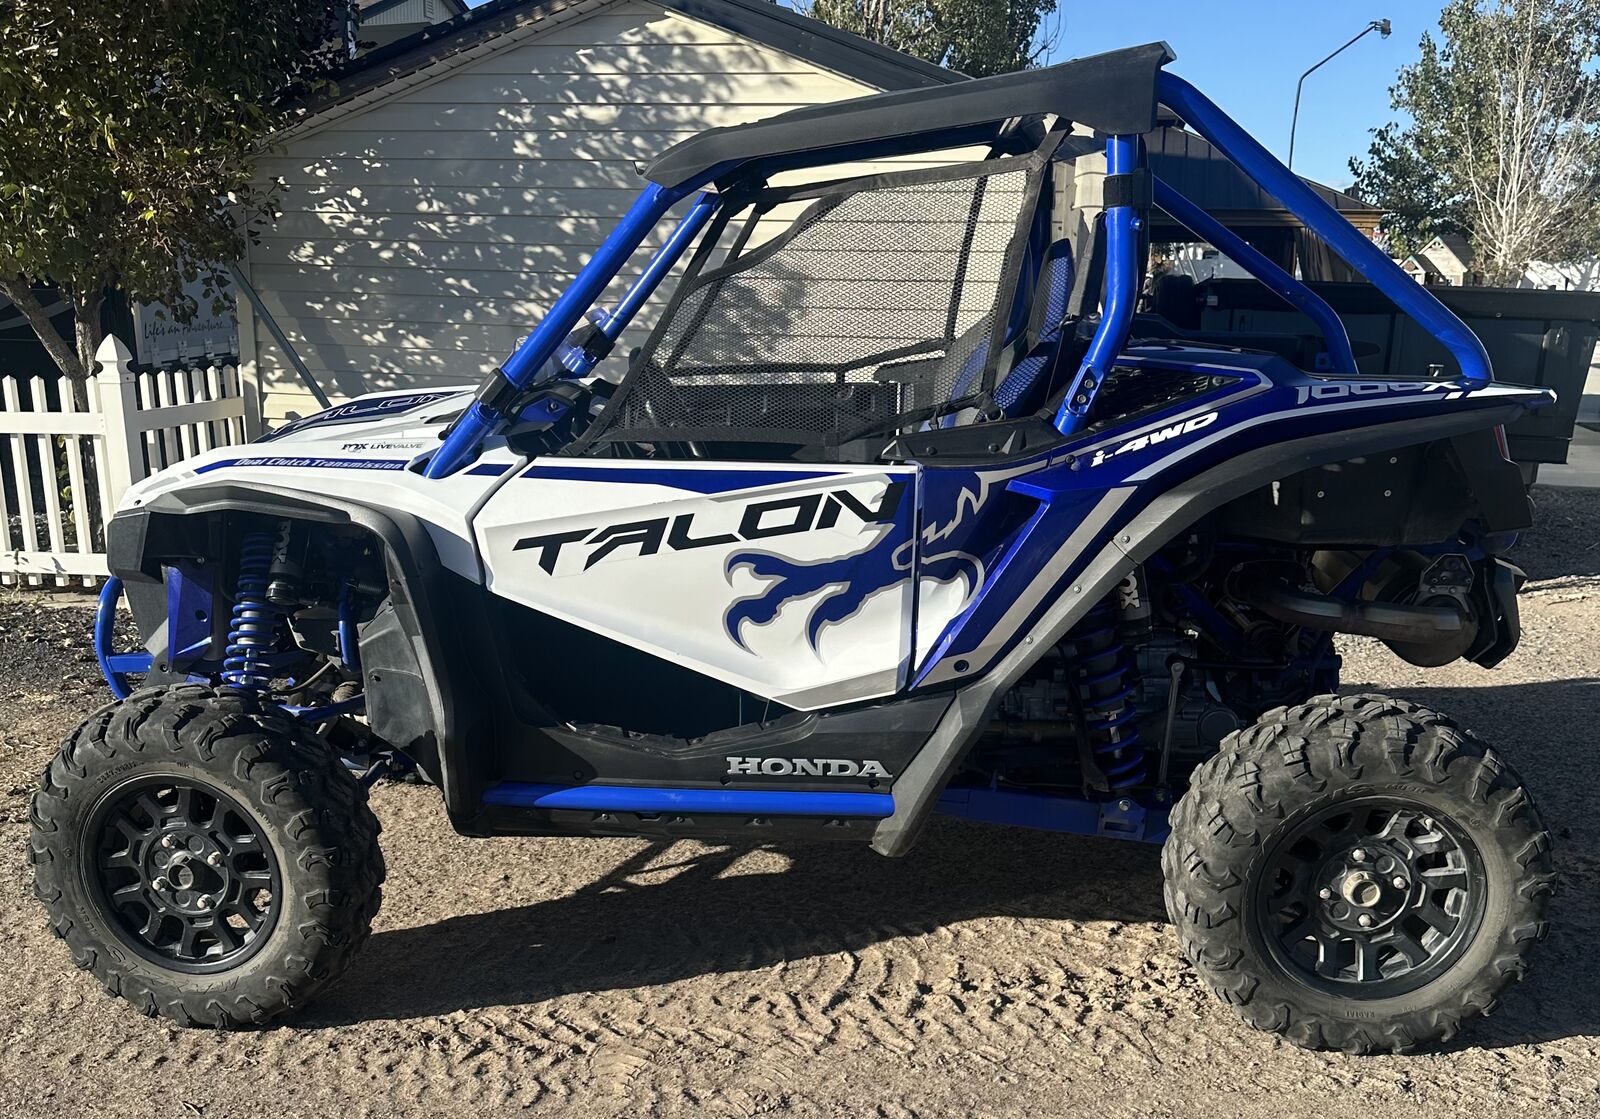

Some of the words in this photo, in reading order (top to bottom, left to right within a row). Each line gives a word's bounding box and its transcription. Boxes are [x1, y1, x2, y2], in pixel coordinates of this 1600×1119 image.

[144, 321, 165, 342] Life's
[168, 325, 180, 335] an
[1296, 381, 1461, 404] 1000X
[341, 442, 368, 453] FOX
[1091, 411, 1218, 467] i-4WD
[233, 457, 263, 466] Dual
[266, 457, 308, 467] Clutch
[311, 459, 404, 470] Transmission
[512, 482, 907, 576] TALON
[1119, 570, 1140, 610] OX
[725, 756, 893, 778] HONDA
